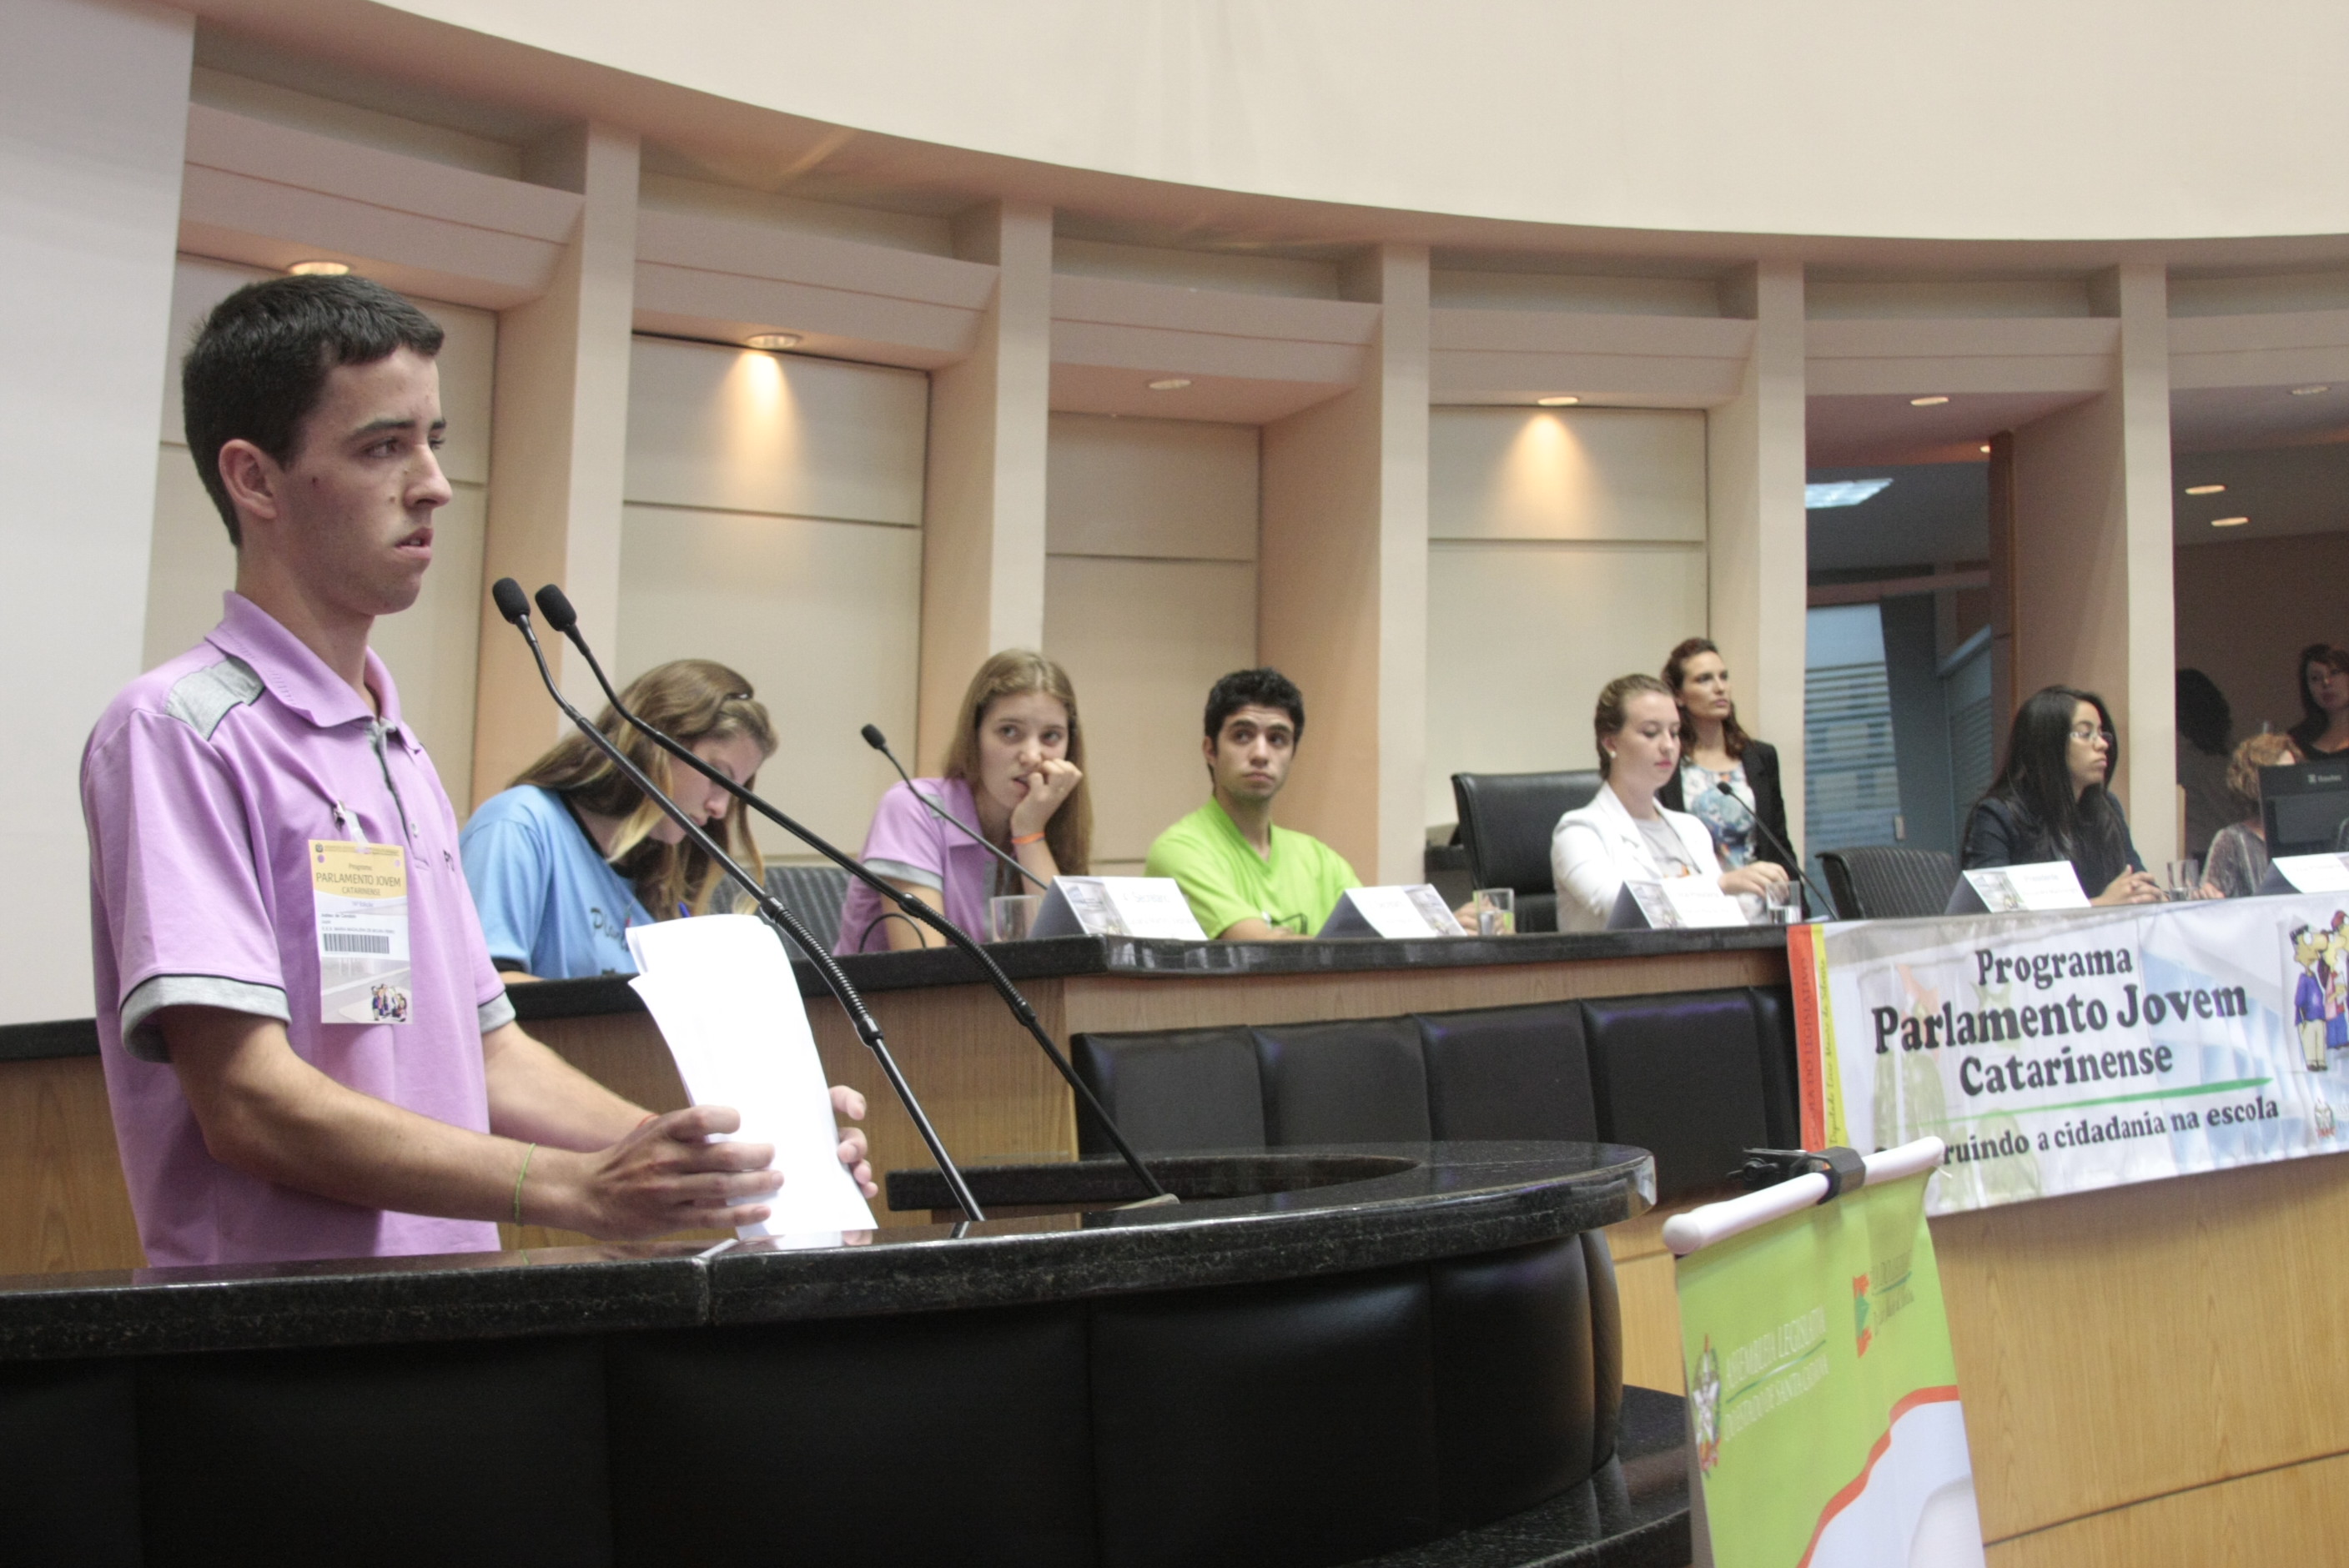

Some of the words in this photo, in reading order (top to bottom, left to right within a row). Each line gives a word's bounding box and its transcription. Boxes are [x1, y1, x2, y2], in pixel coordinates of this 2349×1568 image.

[316, 872, 375, 886] PARLAMENTO
[375, 875, 401, 887] JOVEM
[341, 886, 381, 896] CATARINENSE
[1974, 947, 2133, 991] Programa
[1871, 993, 2108, 1056] Parlamento
[2116, 983, 2249, 1028] Jovem
[1959, 1045, 2173, 1097] Catarinense
[2038, 1132, 2050, 1151] a
[2054, 1115, 2166, 1148] cidadania
[2170, 1113, 2201, 1133] na
[2206, 1095, 2279, 1127] escola
